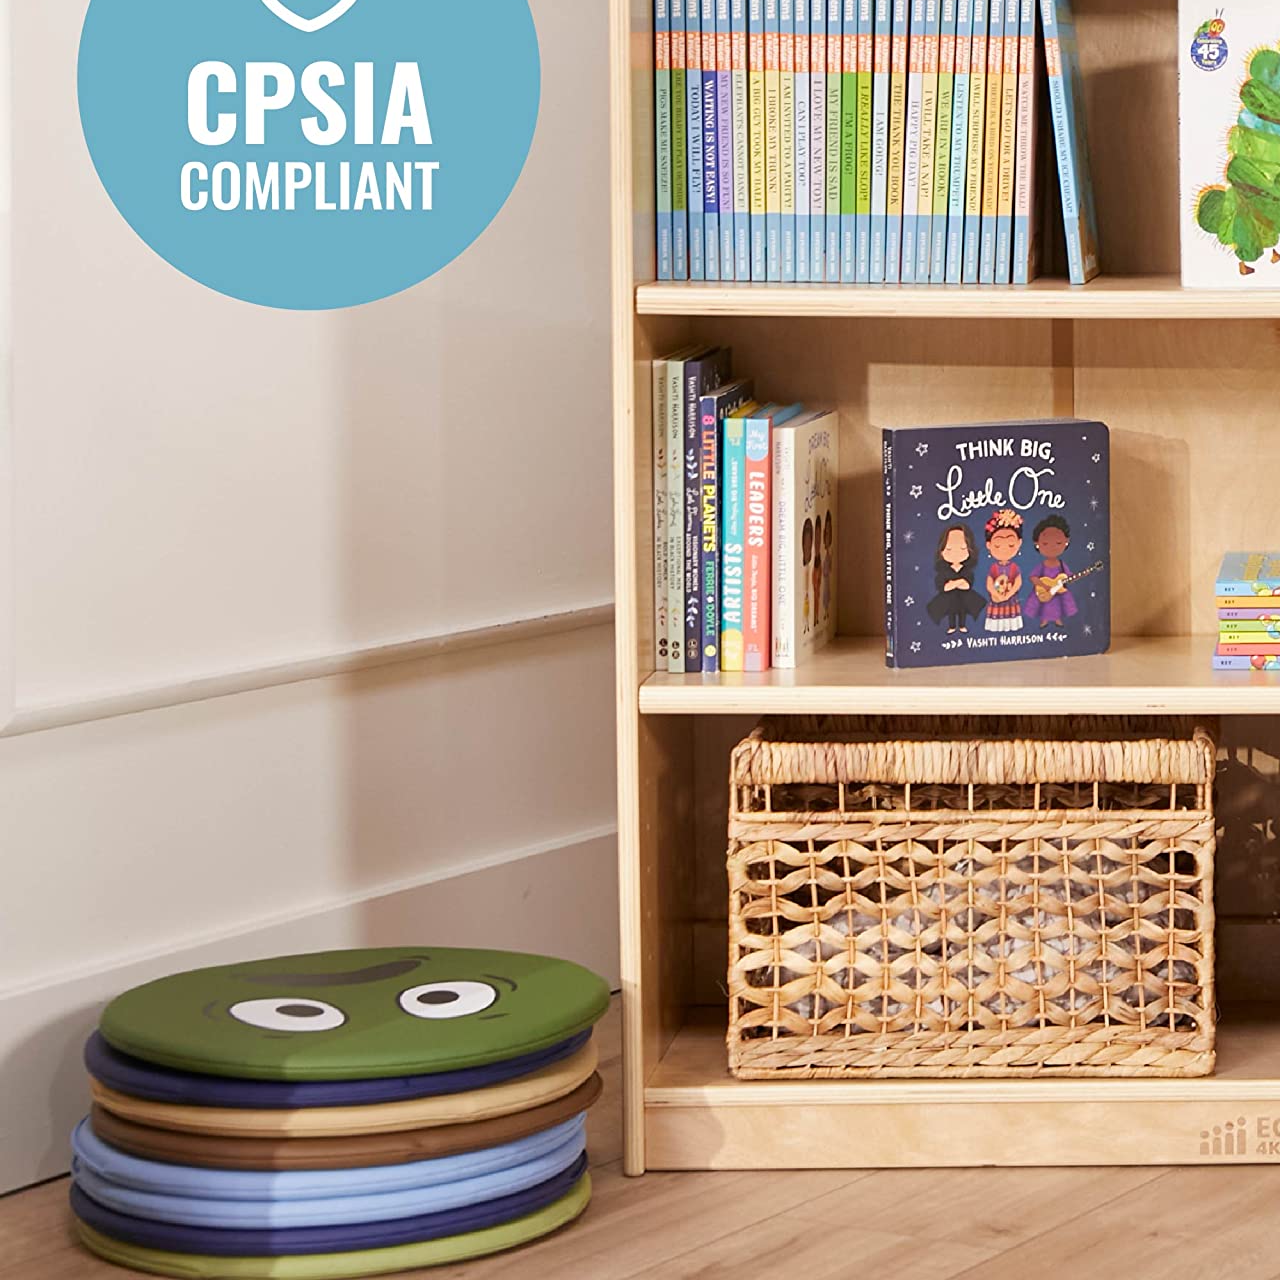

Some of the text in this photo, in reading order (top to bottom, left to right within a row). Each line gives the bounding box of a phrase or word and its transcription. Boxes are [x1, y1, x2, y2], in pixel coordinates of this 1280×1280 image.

[1197, 43, 1220, 61] 45
[691, 85, 699, 122] TODAY
[860, 93, 868, 137] REALLY
[691, 135, 700, 165] WILL
[705, 80, 715, 204] WAITING IS NOT EASY!
[860, 141, 868, 167] LIKE
[692, 170, 700, 193] FLY!
[859, 170, 868, 201] SLOP!
[688, 376, 696, 438] VASHTI HARRISON
[955, 438, 1056, 464] THINK BIG,
[749, 472, 764, 547] LEADERS
[935, 465, 1066, 520] Little One
[702, 415, 715, 636] 8 LITTLE PLANETS FERRIE DOYLE
[777, 535, 785, 552] BIG,
[723, 543, 742, 622] ARTISTS
[966, 634, 1044, 649] VASHTI HARRISON
